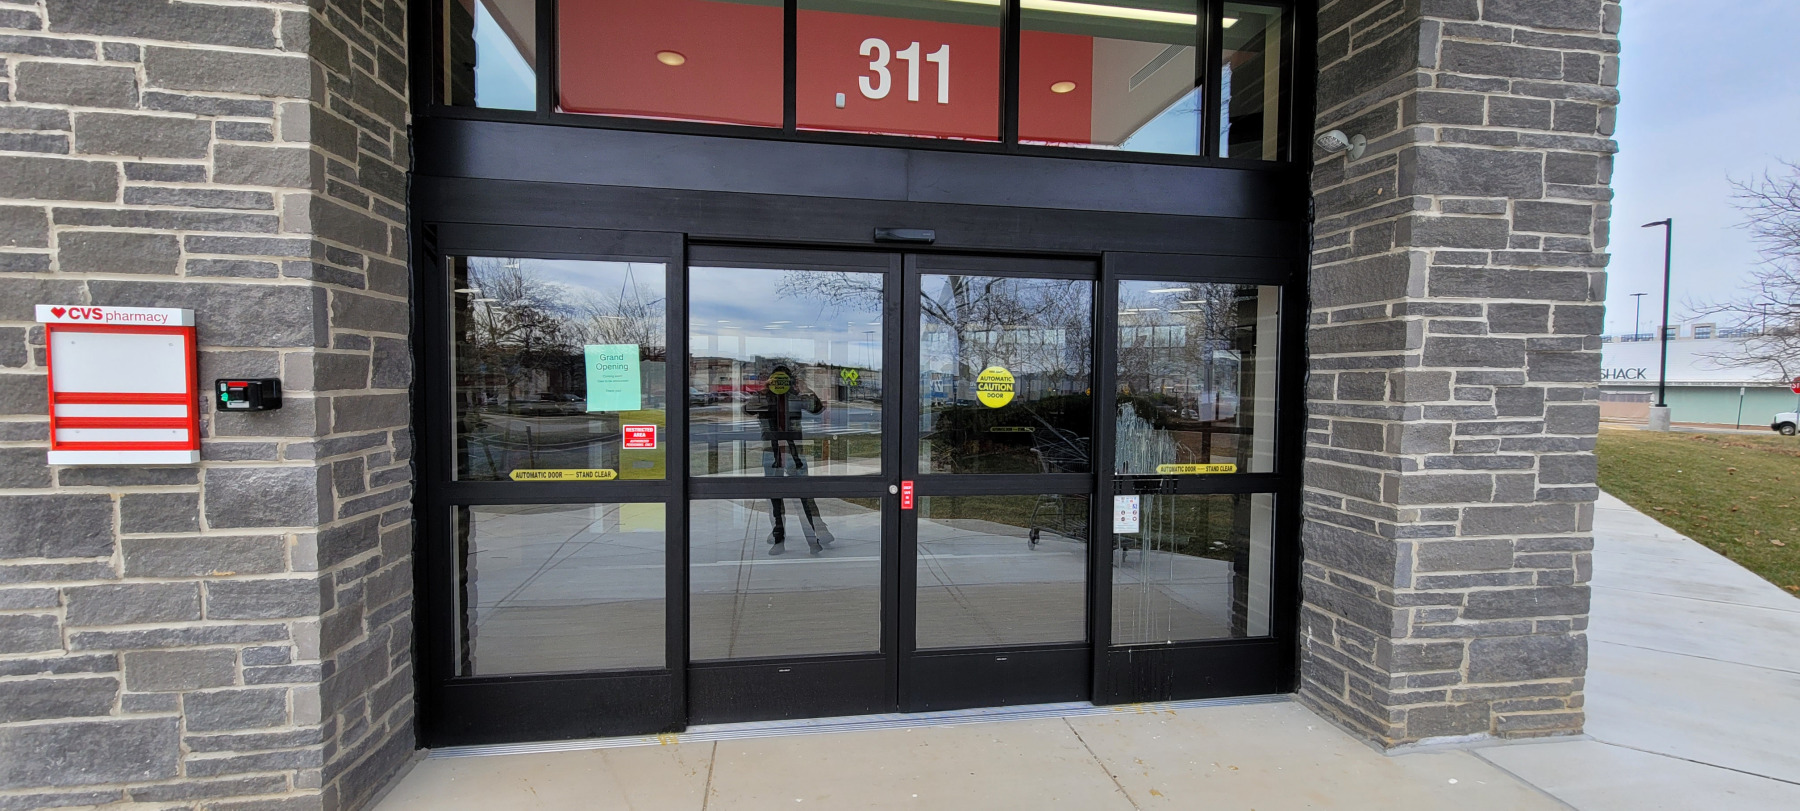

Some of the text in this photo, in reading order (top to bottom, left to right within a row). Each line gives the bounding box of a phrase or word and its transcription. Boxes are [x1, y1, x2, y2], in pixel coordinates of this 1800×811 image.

[858, 37, 950, 104] 311
[68, 307, 168, 324] CVS pharmacy
[599, 353, 624, 361] Grand
[596, 363, 628, 371] Opening
[978, 383, 1013, 391] CAUTION
[515, 471, 547, 479] AUTOMATIC
[594, 470, 612, 478] CLEAR
